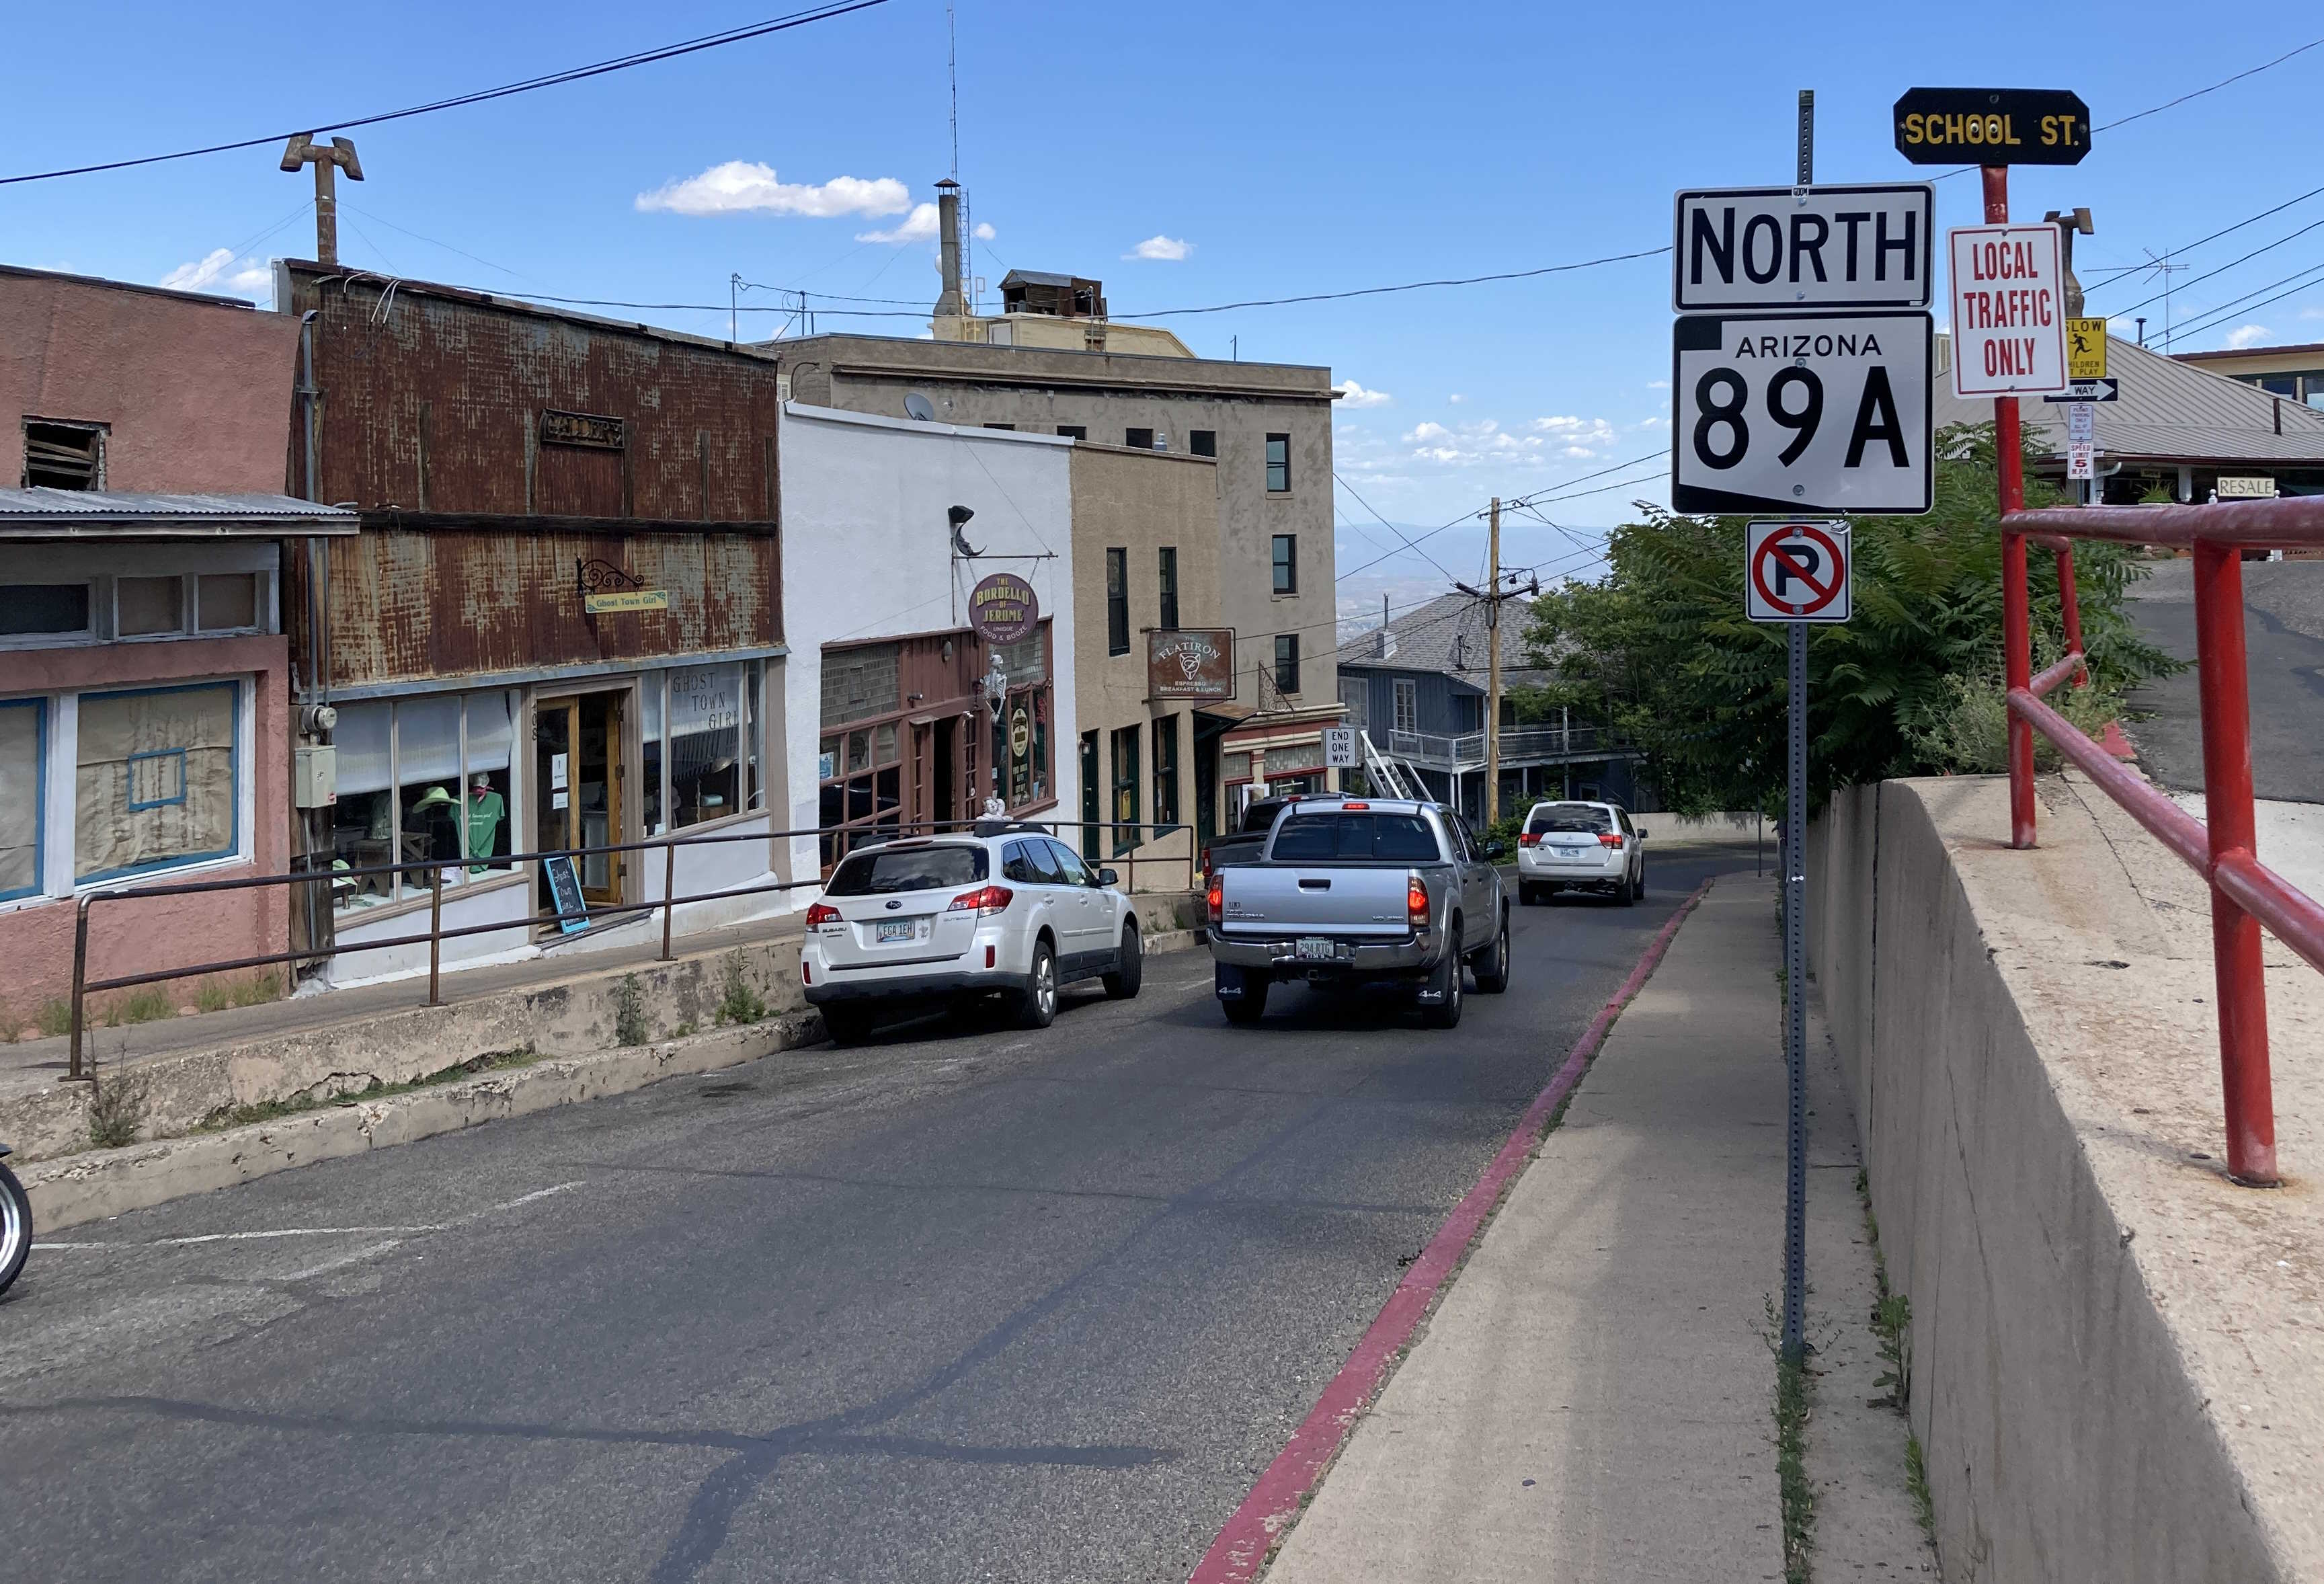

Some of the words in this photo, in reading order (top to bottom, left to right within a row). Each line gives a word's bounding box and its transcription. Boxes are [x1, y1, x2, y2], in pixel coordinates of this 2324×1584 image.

[1905, 114, 2021, 145] SCHOOL
[1691, 207, 1917, 284] NORTH
[1972, 241, 2038, 280] LOCAL
[1963, 288, 2051, 329] TRAFFIC
[1735, 334, 1882, 358] ARIZONA
[1984, 338, 2035, 377] ONLY
[2075, 386, 2095, 395] WAY
[2220, 479, 2272, 494] RESALE
[997, 578, 1008, 586] THE
[597, 599, 617, 607] Ghost
[977, 587, 1030, 607] BORDELLO
[984, 610, 1024, 623] JEROME
[980, 625, 997, 639] FOOD
[1006, 625, 1028, 640] BOOZE
[1159, 642, 1221, 660] FLATIRON
[673, 672, 715, 692] GHOST
[691, 691, 725, 711] TOWN
[1332, 731, 1349, 740] END
[1332, 743, 1349, 752] ONE
[1332, 754, 1349, 764] WAY
[883, 925, 897, 937] EGA
